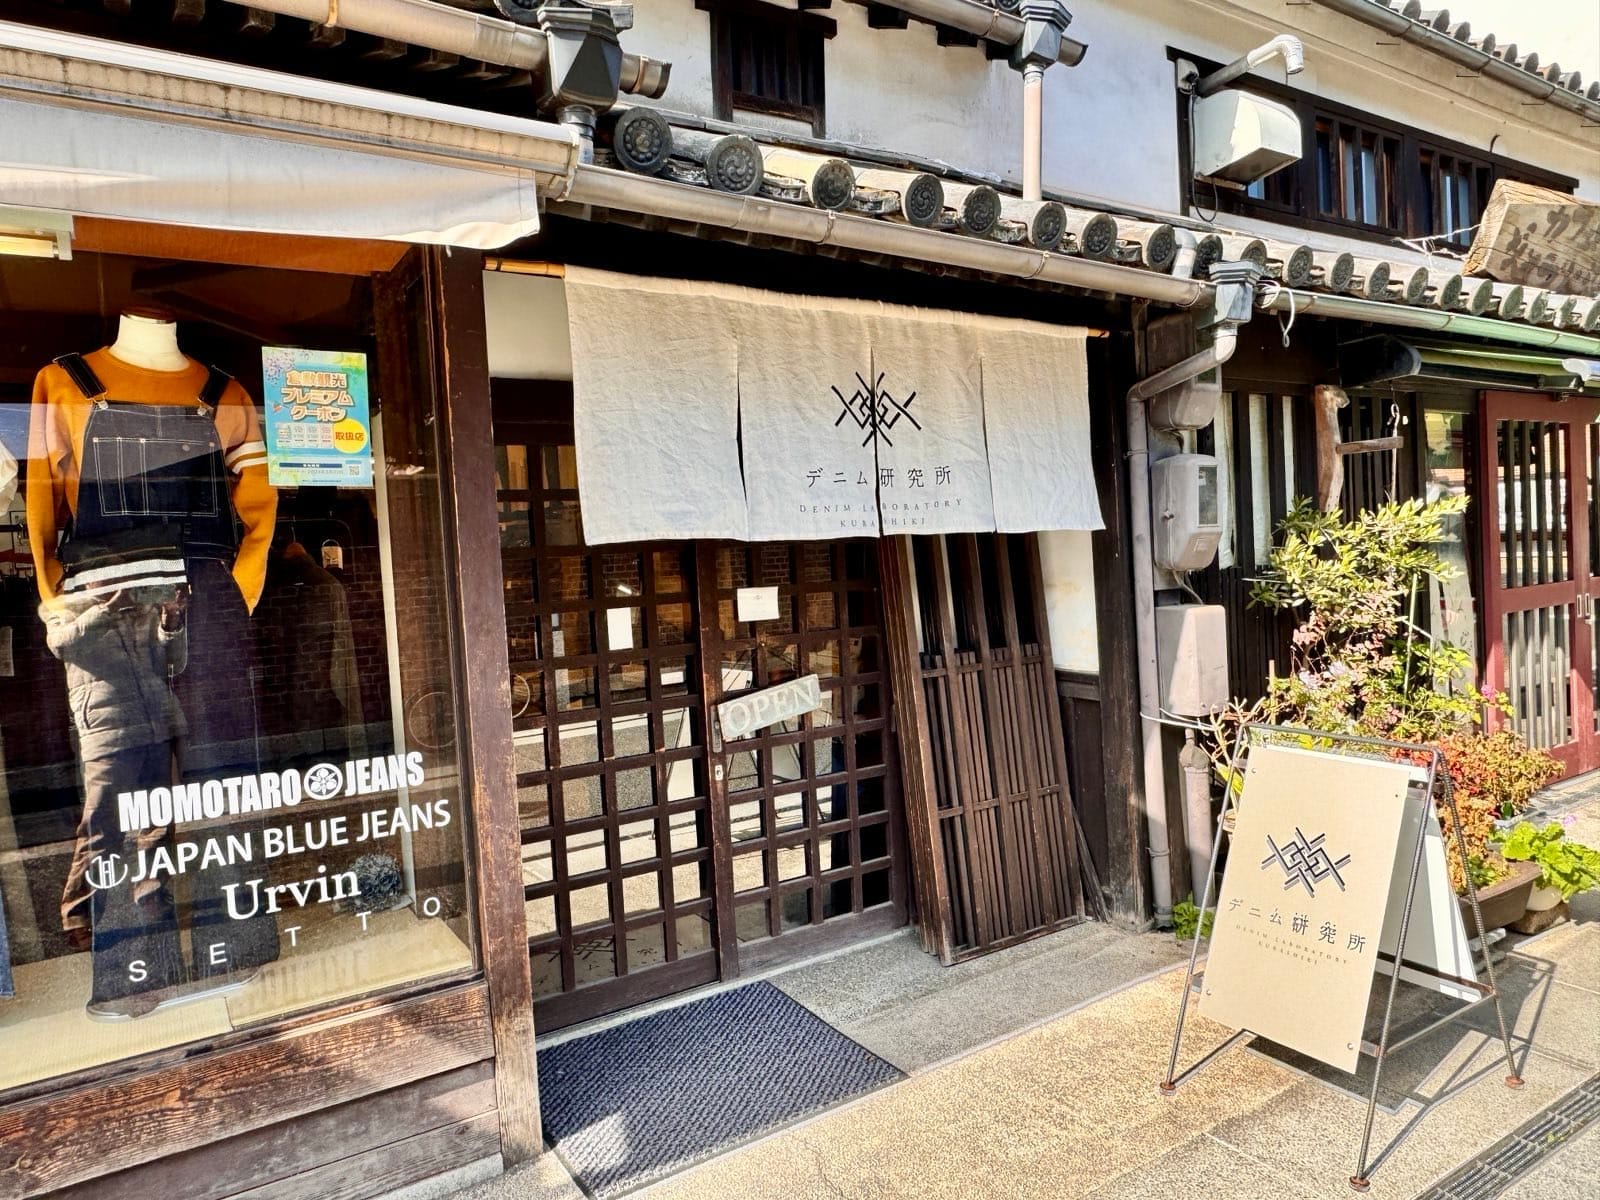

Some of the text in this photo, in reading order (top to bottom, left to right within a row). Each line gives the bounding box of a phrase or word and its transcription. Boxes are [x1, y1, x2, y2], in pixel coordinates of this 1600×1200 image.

[281, 387, 354, 406] プレミアム
[291, 405, 346, 423] クーポン
[335, 432, 364, 442] 取扱店
[806, 465, 952, 489] デニム研究所
[799, 503, 851, 514] DENIM
[722, 680, 816, 733] OPEN
[117, 751, 424, 832] MOMOTARO JEANS
[131, 799, 451, 883] JAPAN BLUE JEANS
[221, 865, 362, 920] Urvin
[1228, 897, 1367, 954] デニム研究所
